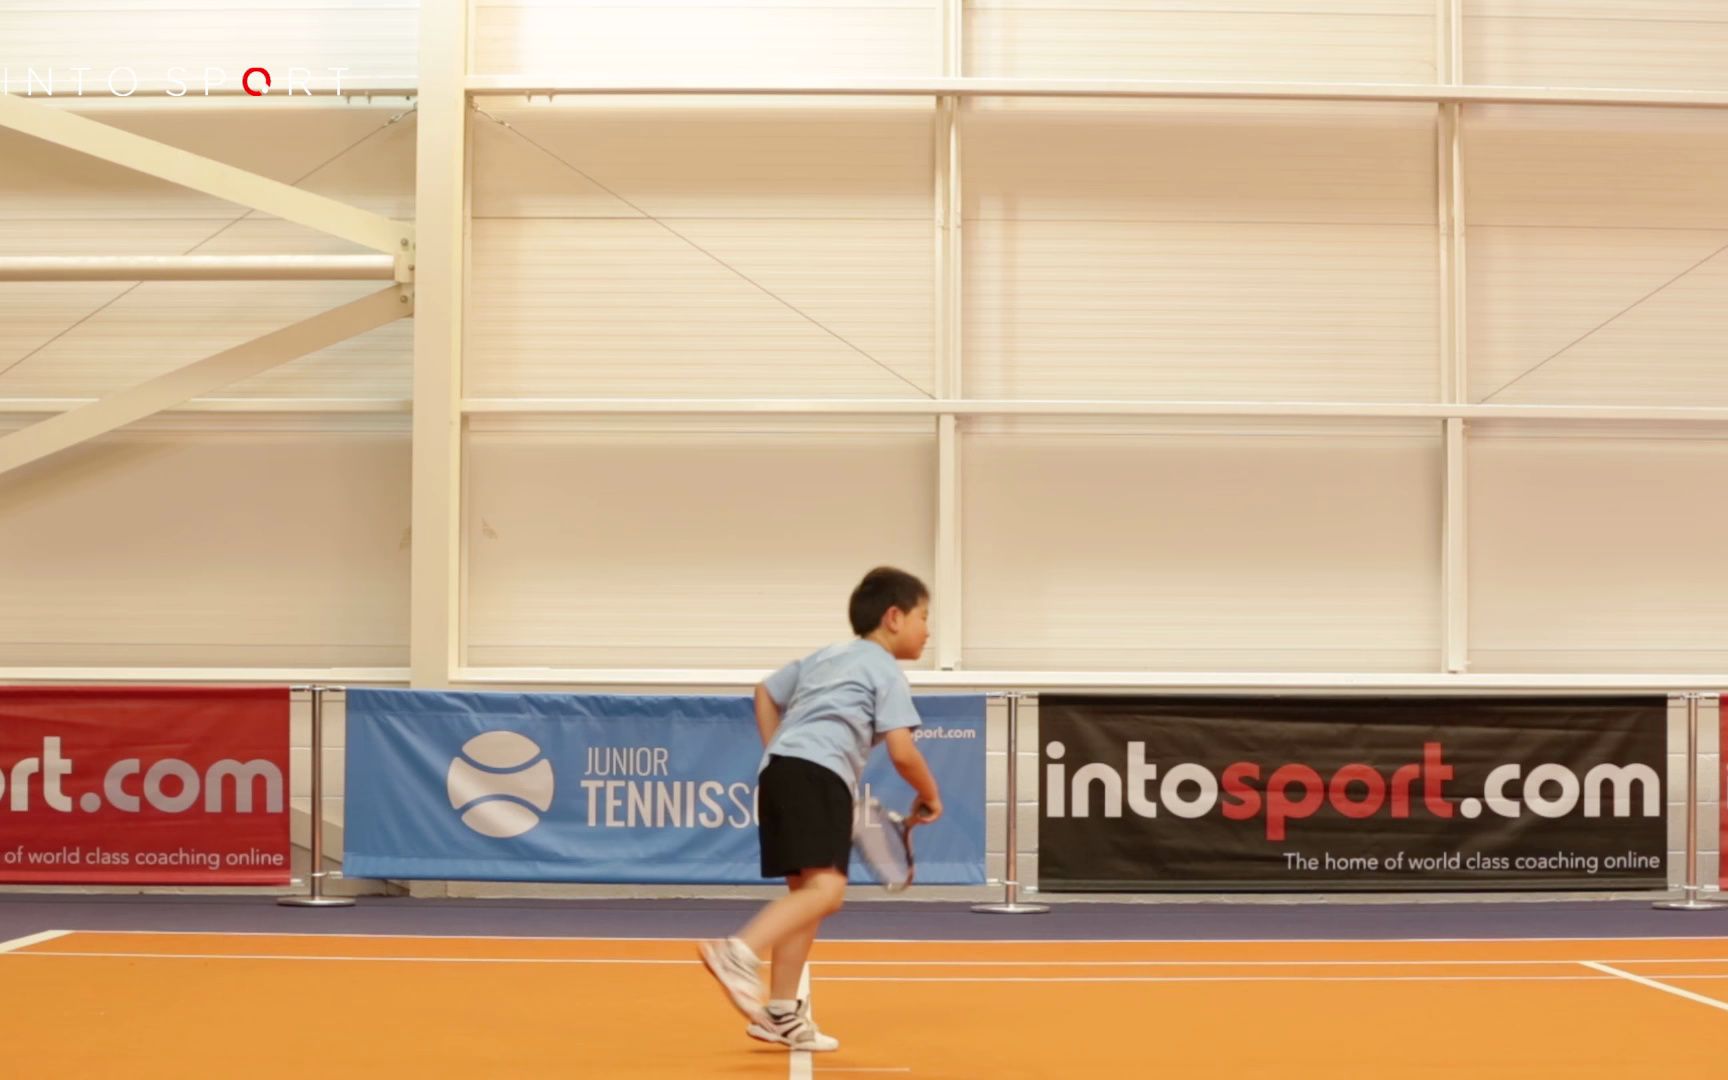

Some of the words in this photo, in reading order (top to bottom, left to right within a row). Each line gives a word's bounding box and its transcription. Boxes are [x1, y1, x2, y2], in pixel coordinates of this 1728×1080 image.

[912, 726, 977, 742] port.com
[0, 735, 284, 814] rt.com
[584, 747, 669, 776] JUNIOR
[580, 780, 883, 829] TENNISSL
[1046, 740, 1661, 841] intosport.com
[4, 846, 24, 864] of
[28, 847, 80, 865] world
[85, 848, 130, 865] class
[135, 848, 220, 870] coaching
[226, 848, 285, 866] online
[1283, 852, 1320, 871] The
[1324, 852, 1379, 871] home
[1384, 851, 1404, 870] of
[1408, 851, 1461, 871] world
[1465, 851, 1510, 870] class
[1514, 851, 1599, 873] coaching
[1603, 850, 1661, 869] online
